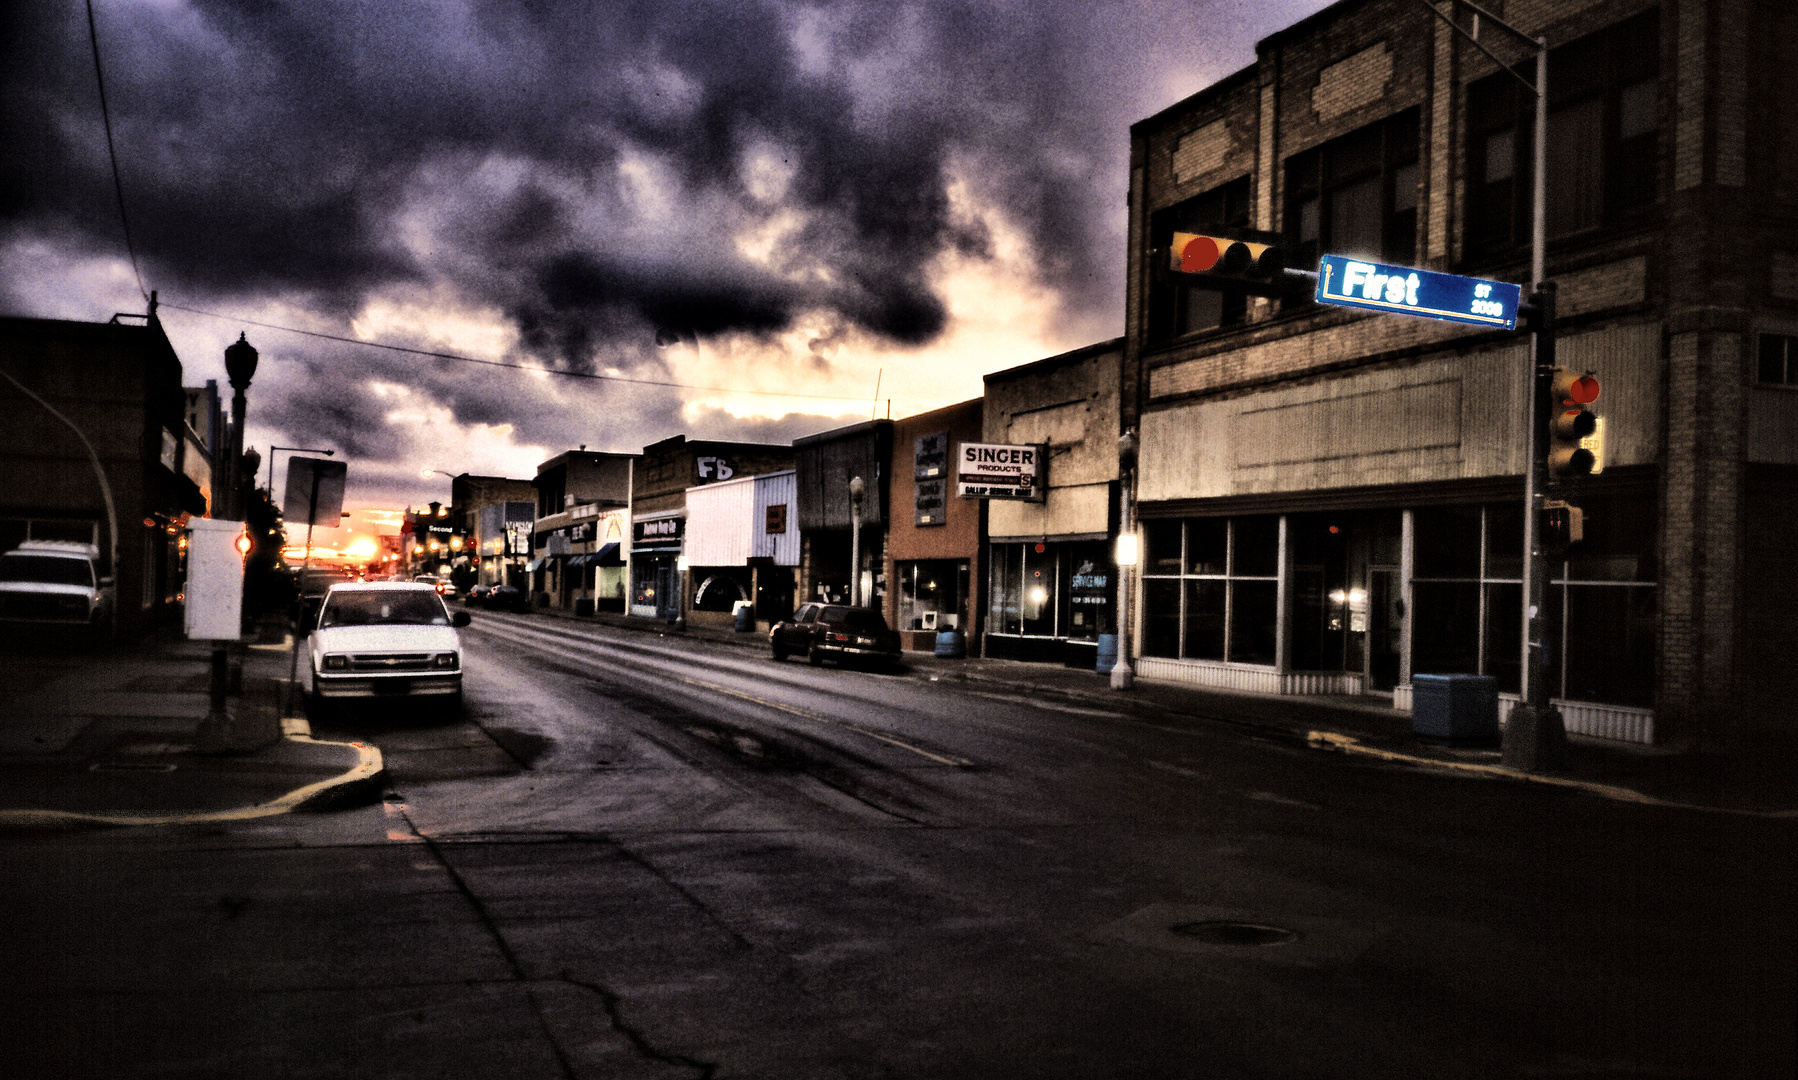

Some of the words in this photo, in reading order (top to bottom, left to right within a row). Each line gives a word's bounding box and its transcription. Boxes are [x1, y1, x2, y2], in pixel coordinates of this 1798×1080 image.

[1342, 260, 1420, 305] First
[1474, 283, 1493, 298] ST
[966, 447, 1033, 465] SINGER
[977, 464, 1022, 473] PRODUCTS
[428, 524, 454, 534] Second
